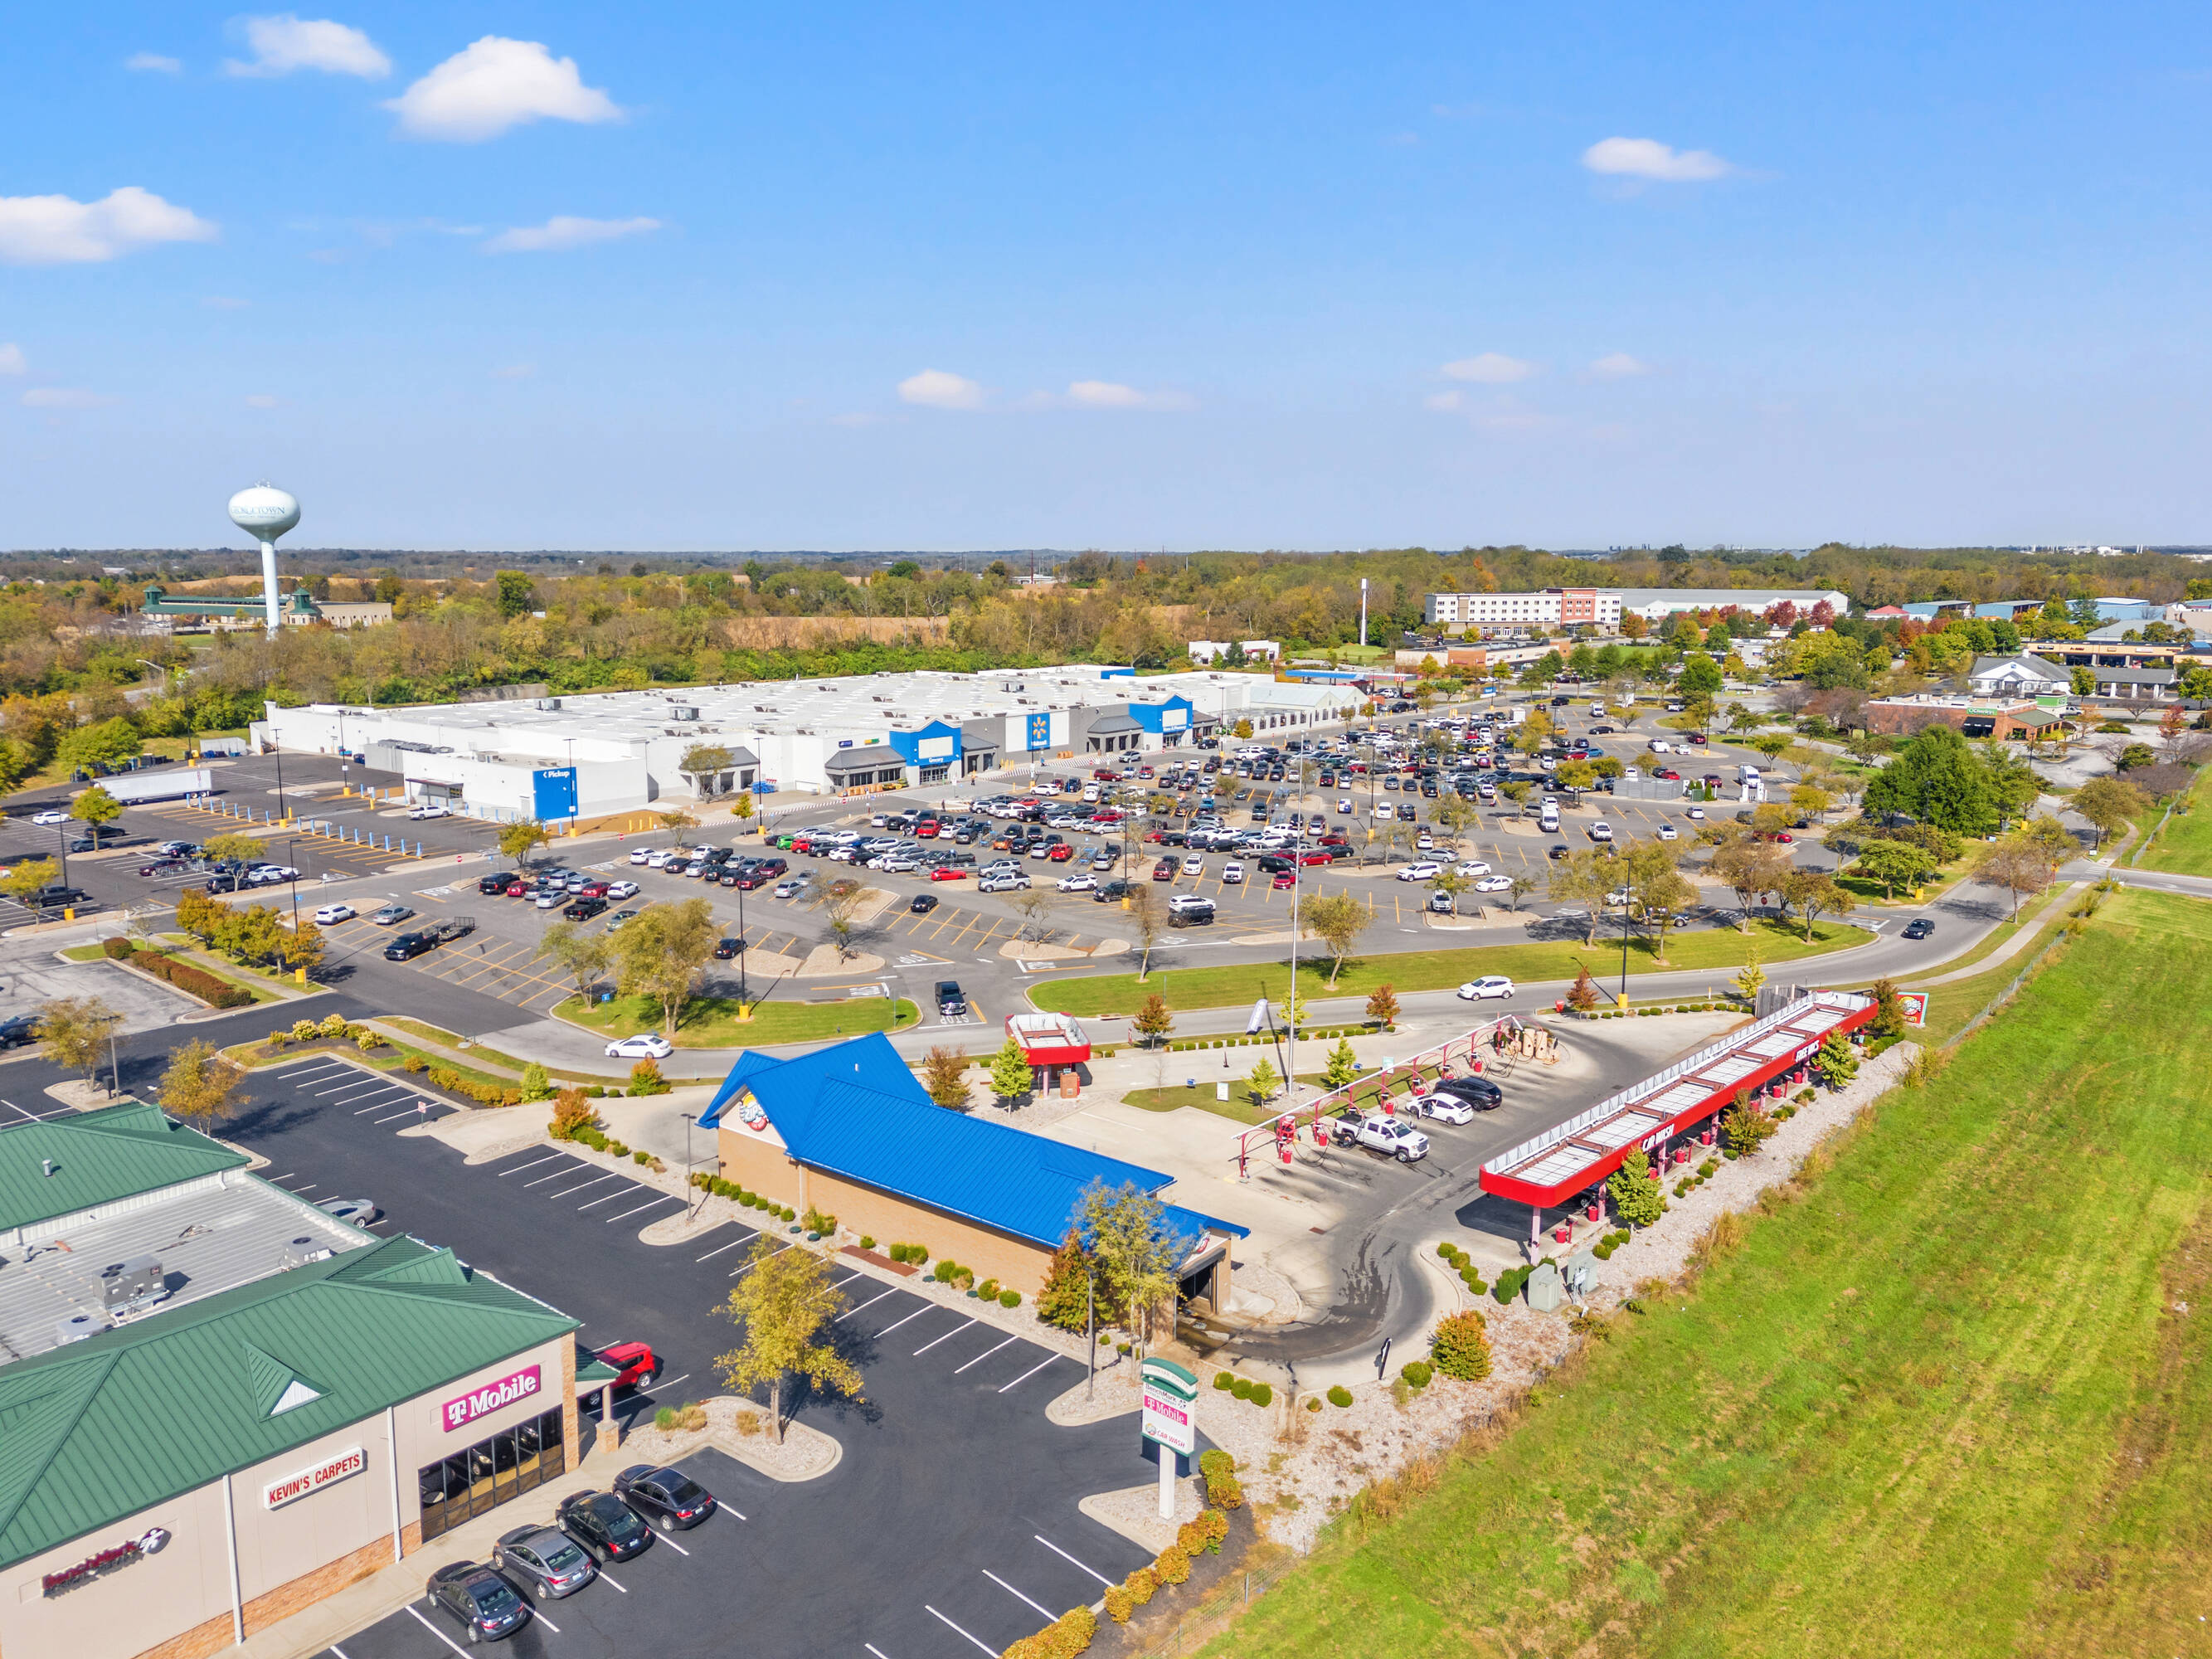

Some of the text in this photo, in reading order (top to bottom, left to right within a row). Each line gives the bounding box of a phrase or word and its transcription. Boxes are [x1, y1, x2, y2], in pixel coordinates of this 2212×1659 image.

[548, 770, 570, 778] Pickup
[1642, 1134, 1656, 1153] CAR
[469, 1374, 537, 1418] Mobile
[1156, 1401, 1185, 1425] Mobile
[1157, 1428, 1168, 1440] CAR
[1169, 1435, 1186, 1447] WASH
[270, 1454, 360, 1504] KEVIN'S CARPETS
